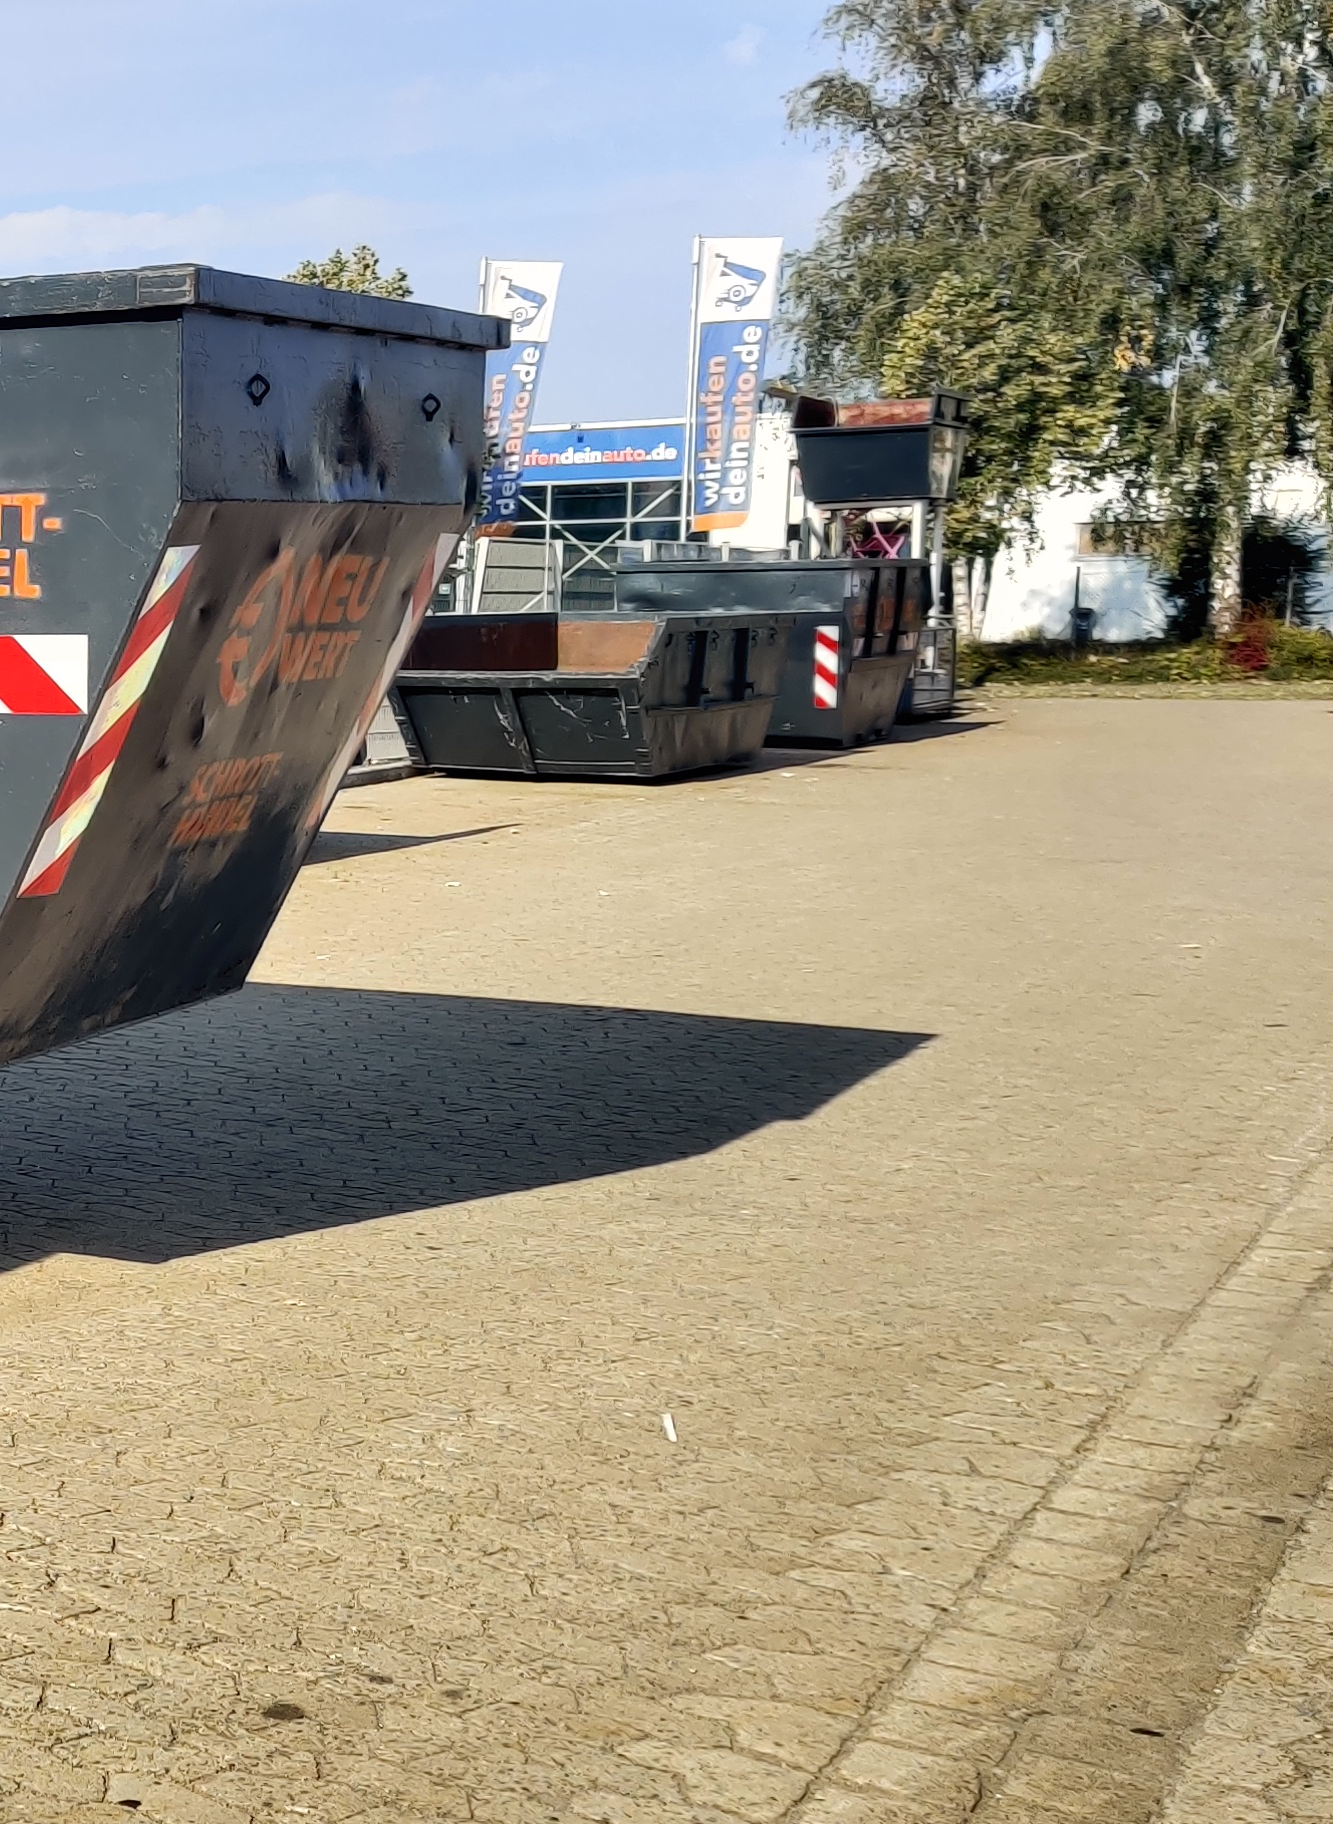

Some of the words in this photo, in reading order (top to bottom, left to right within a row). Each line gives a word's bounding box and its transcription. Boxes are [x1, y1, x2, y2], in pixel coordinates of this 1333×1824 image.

[495, 345, 541, 516] deinauto.de
[698, 354, 728, 507] wirkaufen
[719, 324, 763, 506] deinauto.de
[278, 630, 363, 684] WERT
[289, 553, 391, 626] NEU
